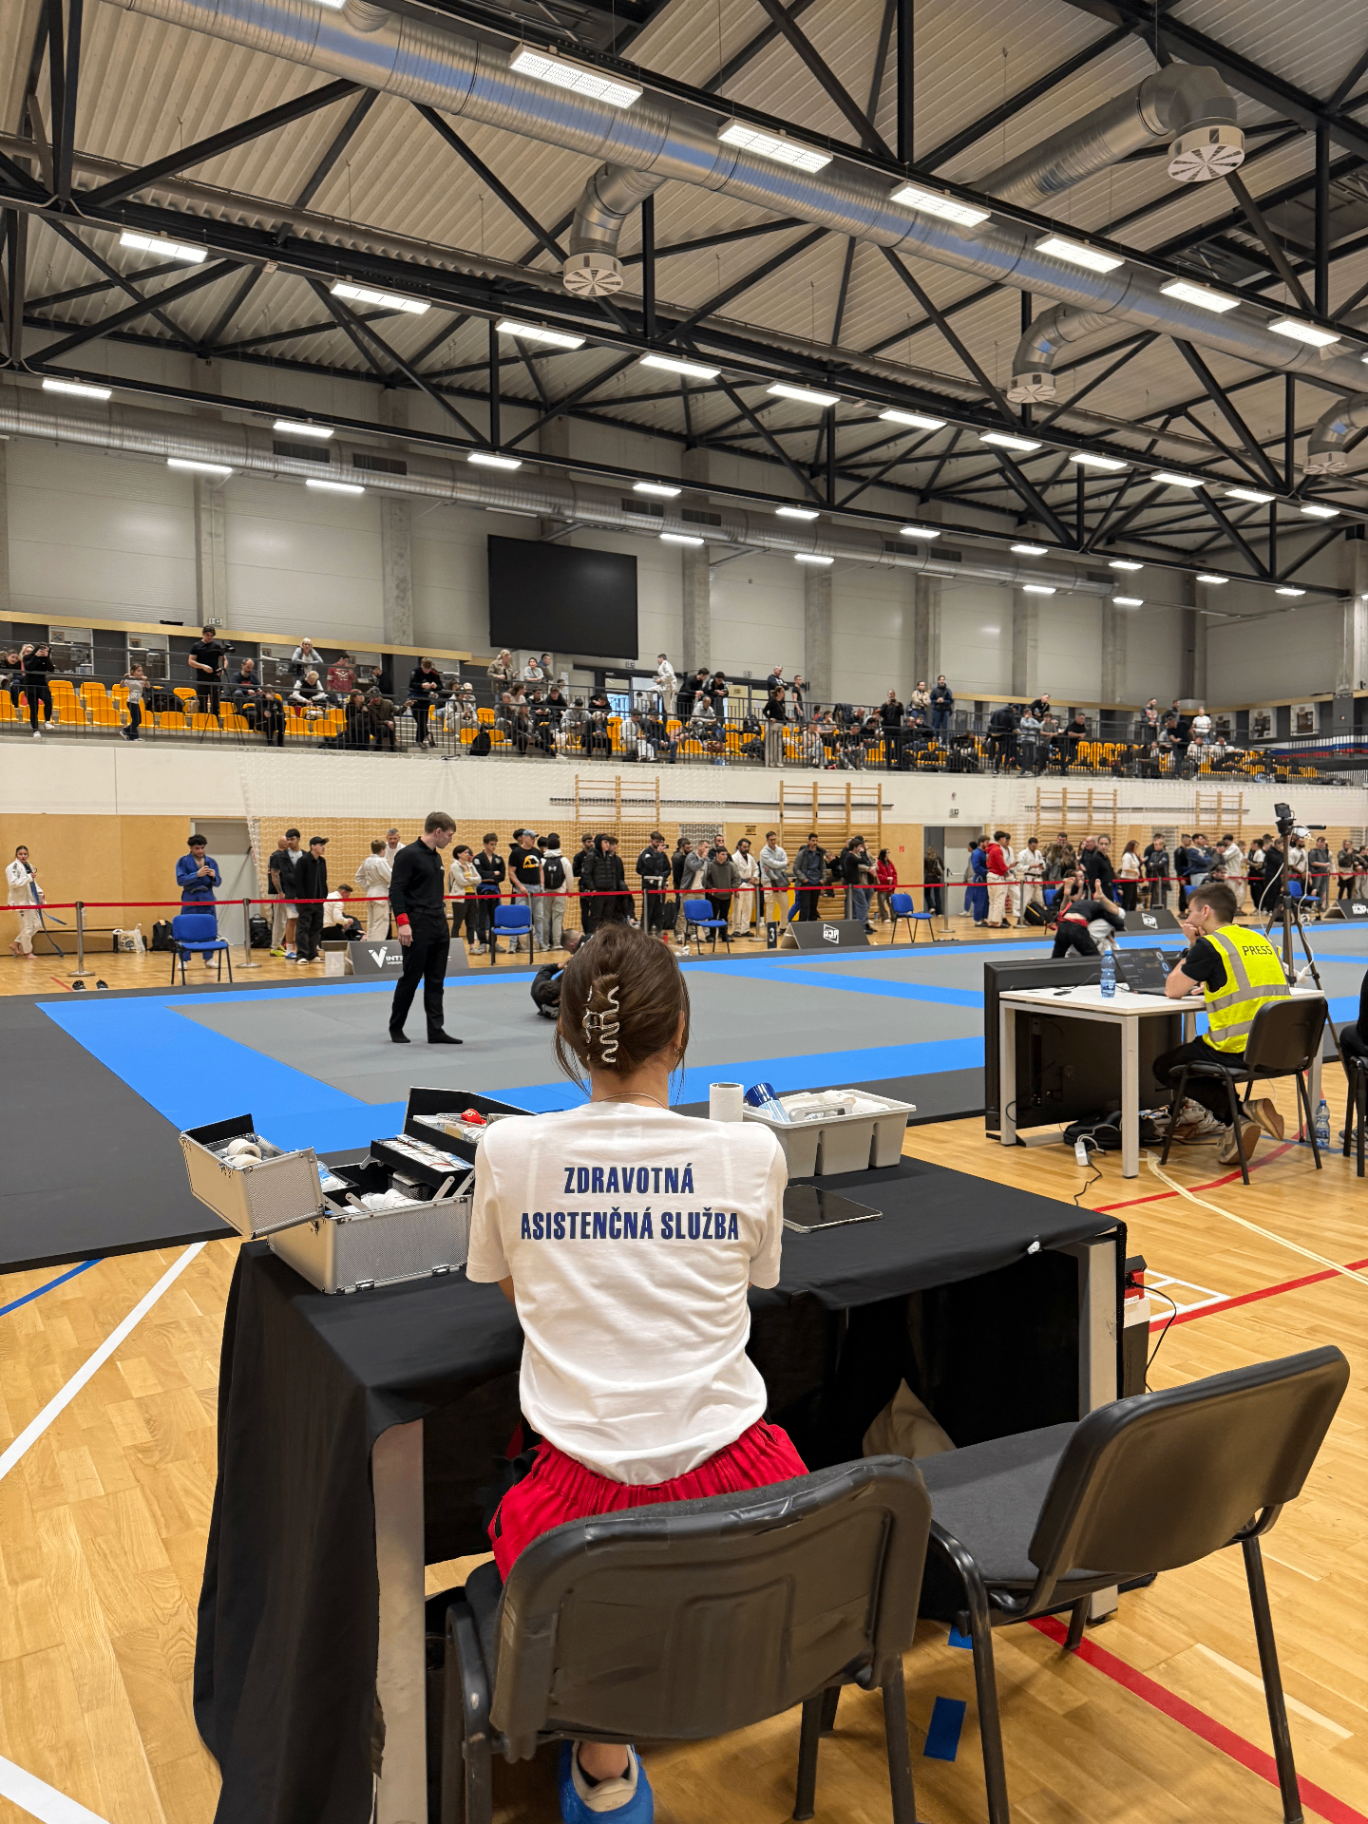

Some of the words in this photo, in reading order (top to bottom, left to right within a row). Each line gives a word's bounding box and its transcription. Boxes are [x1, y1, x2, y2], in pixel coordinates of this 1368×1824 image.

[769, 927, 776, 942] 3
[1241, 945, 1273, 957] PRESS
[564, 1163, 694, 1194] ZDRAVOTNÁ
[521, 1207, 654, 1240] ASISTENČNÁ
[660, 1207, 739, 1240] SLUŽBA
